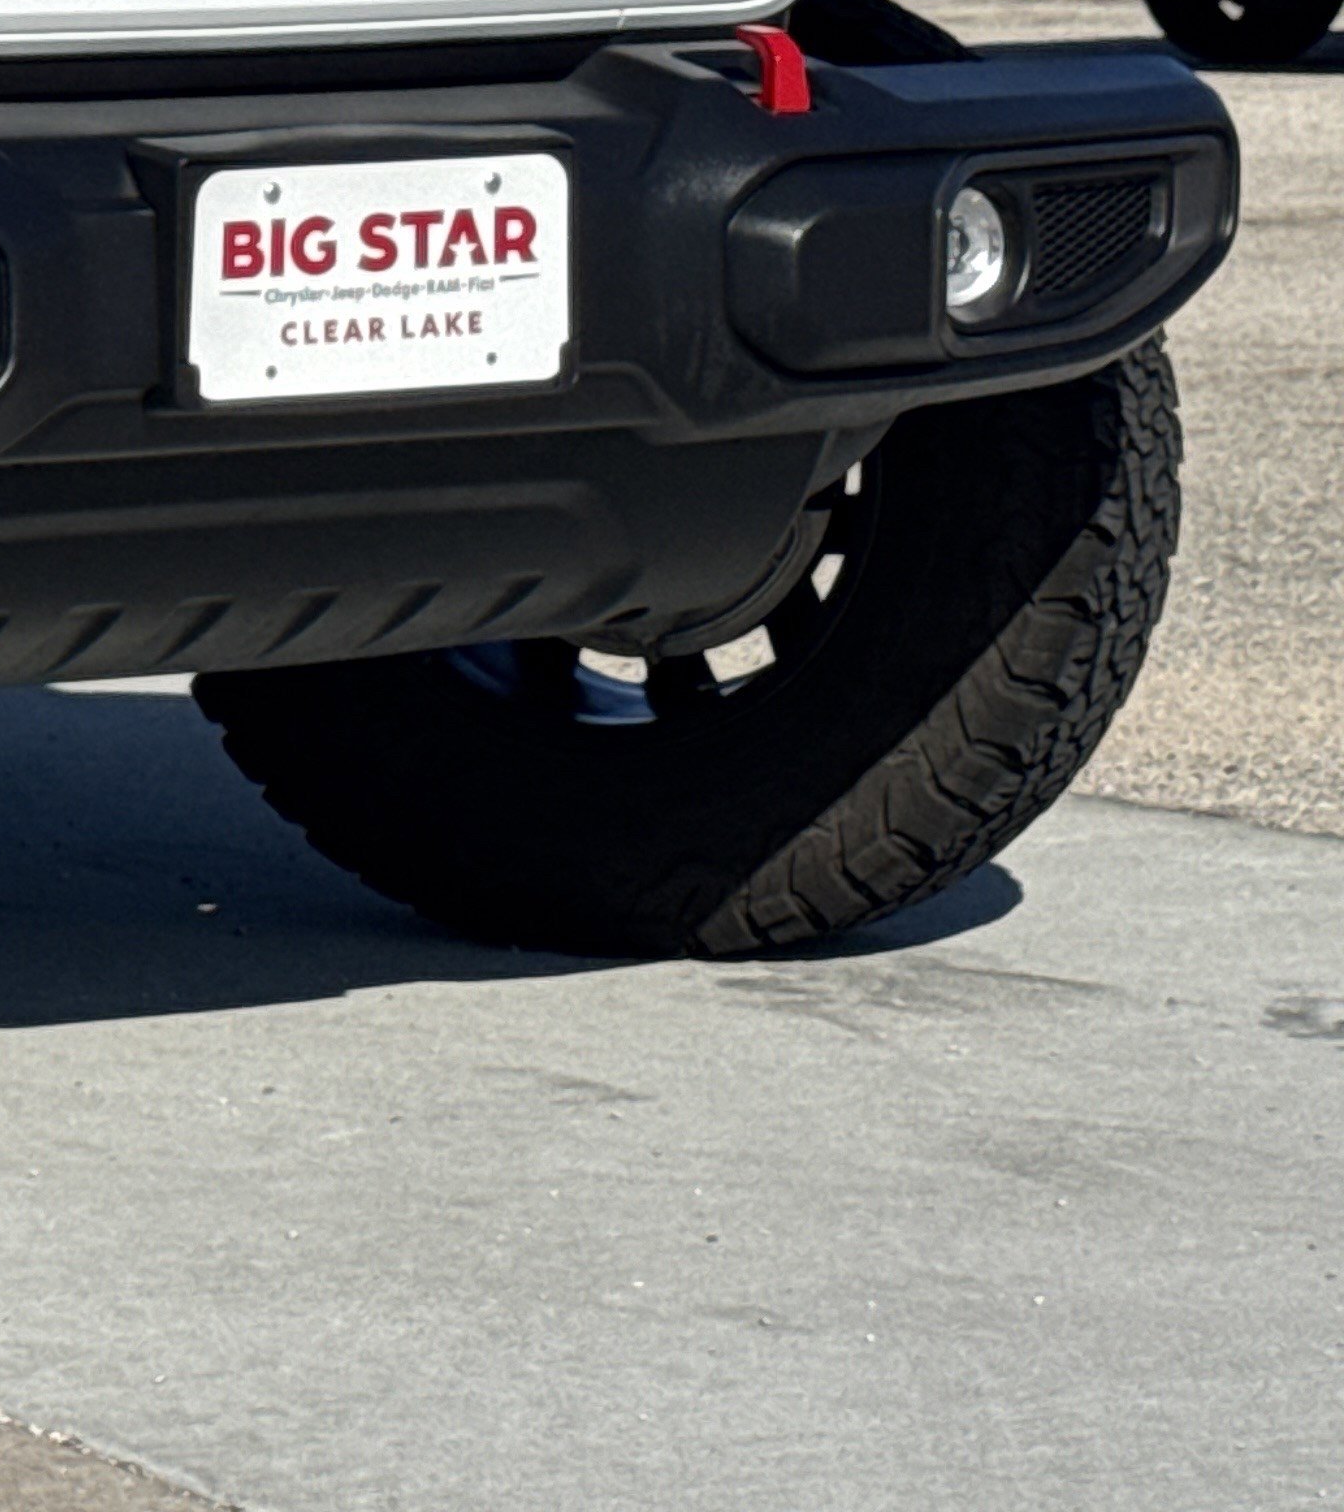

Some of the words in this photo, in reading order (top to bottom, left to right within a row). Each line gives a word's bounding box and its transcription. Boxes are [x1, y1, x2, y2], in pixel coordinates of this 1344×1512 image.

[222, 217, 337, 279] BIG
[358, 205, 538, 272] STAR
[280, 317, 386, 347] CLEAR
[400, 310, 484, 340] LAKE
